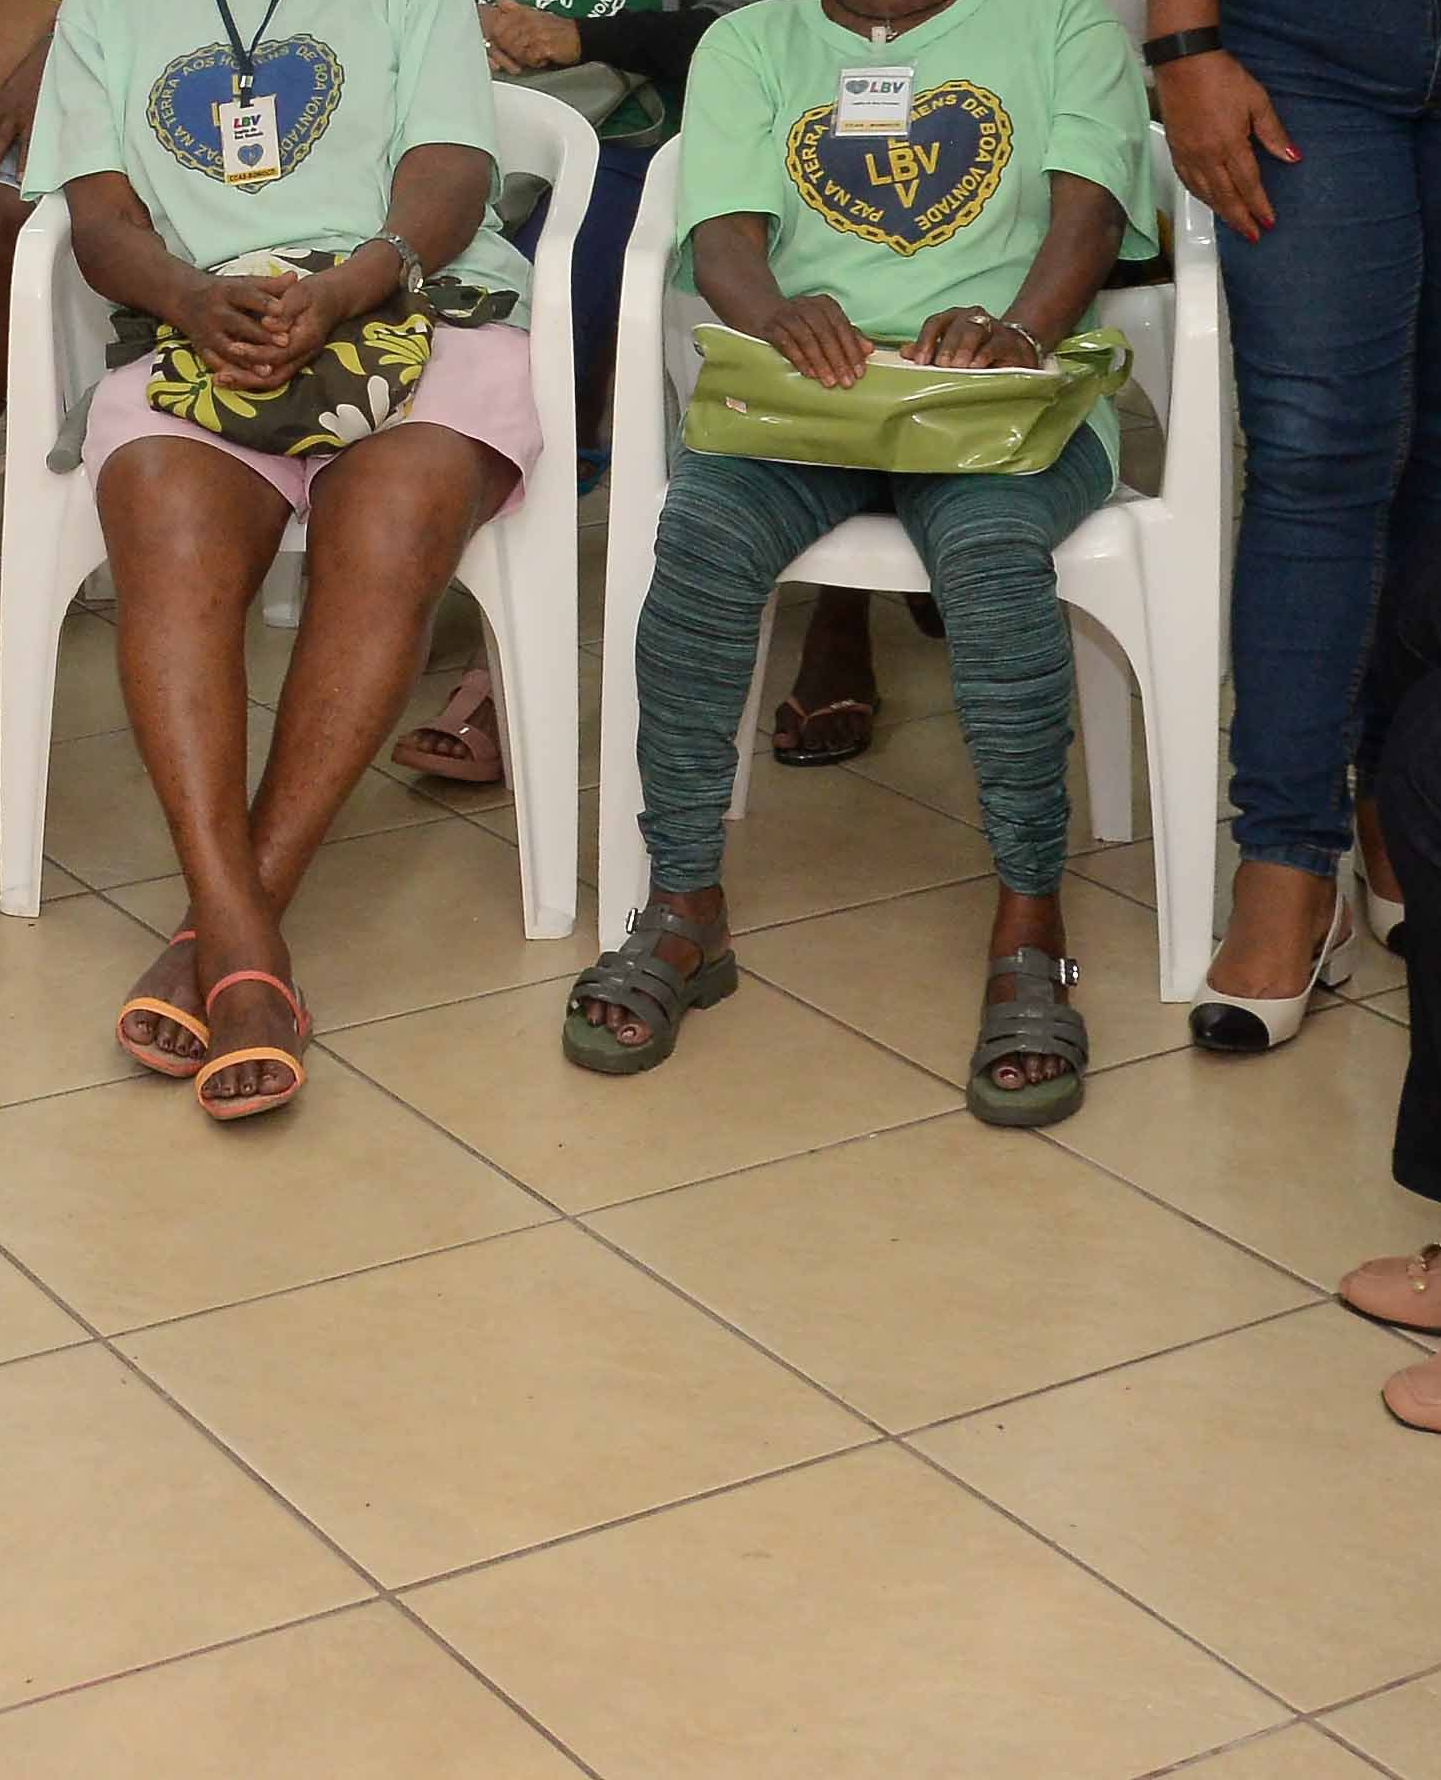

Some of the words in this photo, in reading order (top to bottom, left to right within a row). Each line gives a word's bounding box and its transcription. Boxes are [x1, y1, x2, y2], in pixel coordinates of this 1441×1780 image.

[182, 56, 215, 77] AOS
[296, 45, 317, 62] DE
[314, 63, 328, 92] BOA
[870, 81, 904, 93] LBV
[160, 78, 180, 126] TERRA
[961, 96, 990, 119] DE
[233, 114, 261, 129] LBV
[174, 125, 195, 148] NA
[975, 122, 996, 163] BOA
[802, 124, 830, 184] TERRA
[864, 142, 940, 186] LBV
[822, 179, 853, 207] NA
[895, 179, 920, 209] V
[914, 166, 987, 230] VONTADE
[849, 198, 886, 222] PAZ
